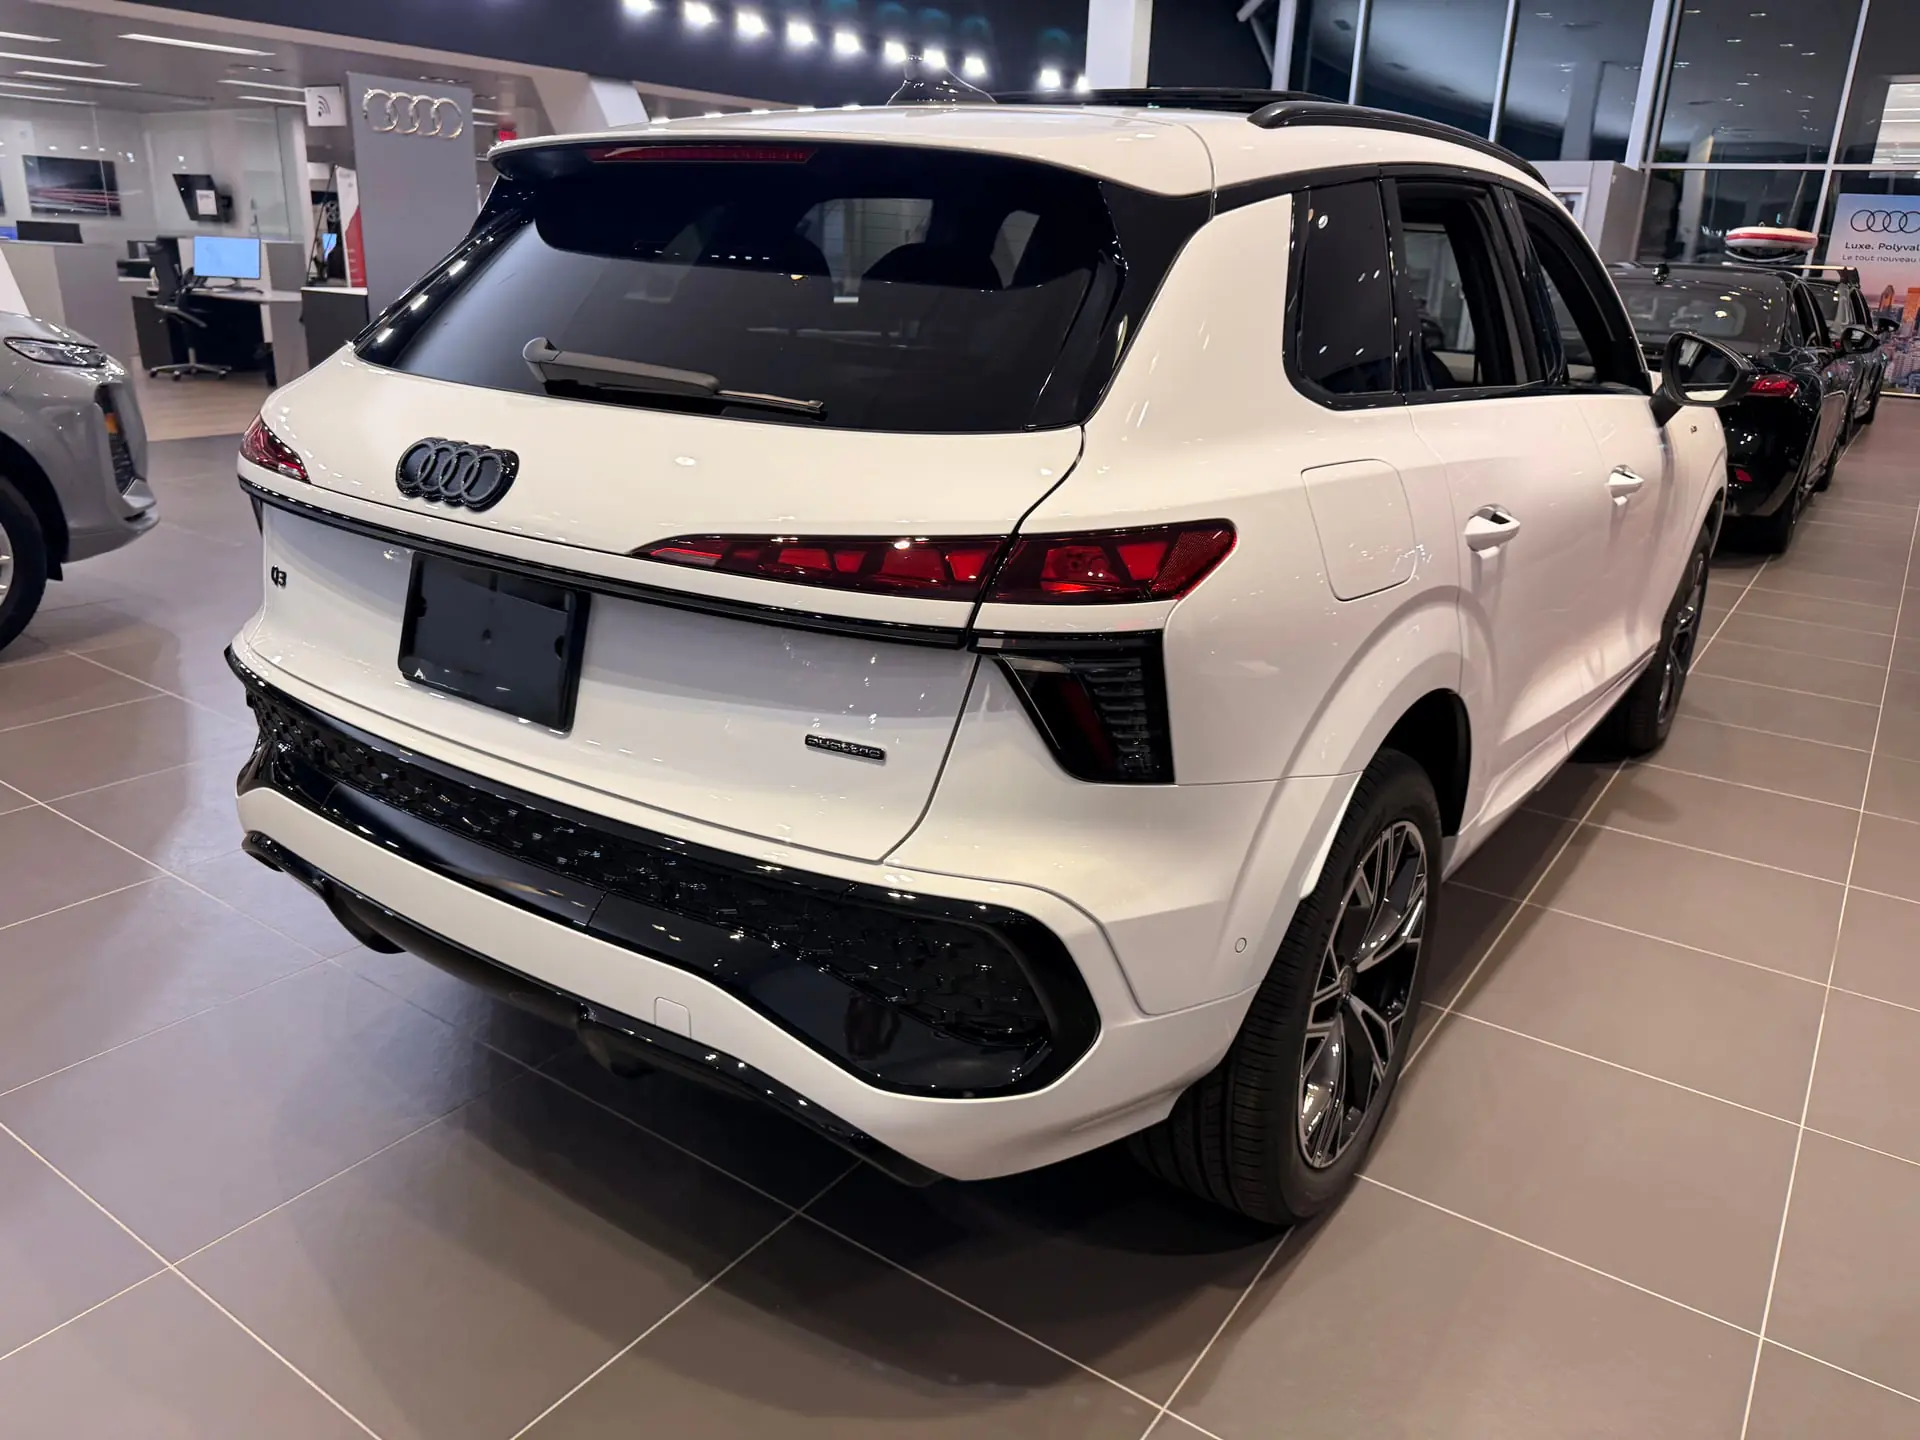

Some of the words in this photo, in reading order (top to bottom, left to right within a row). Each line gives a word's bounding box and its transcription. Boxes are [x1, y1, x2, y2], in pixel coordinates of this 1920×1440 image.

[1845, 242, 1874, 250] Luxe.
[1842, 253, 1853, 261] Le
[271, 565, 287, 589] Q3
